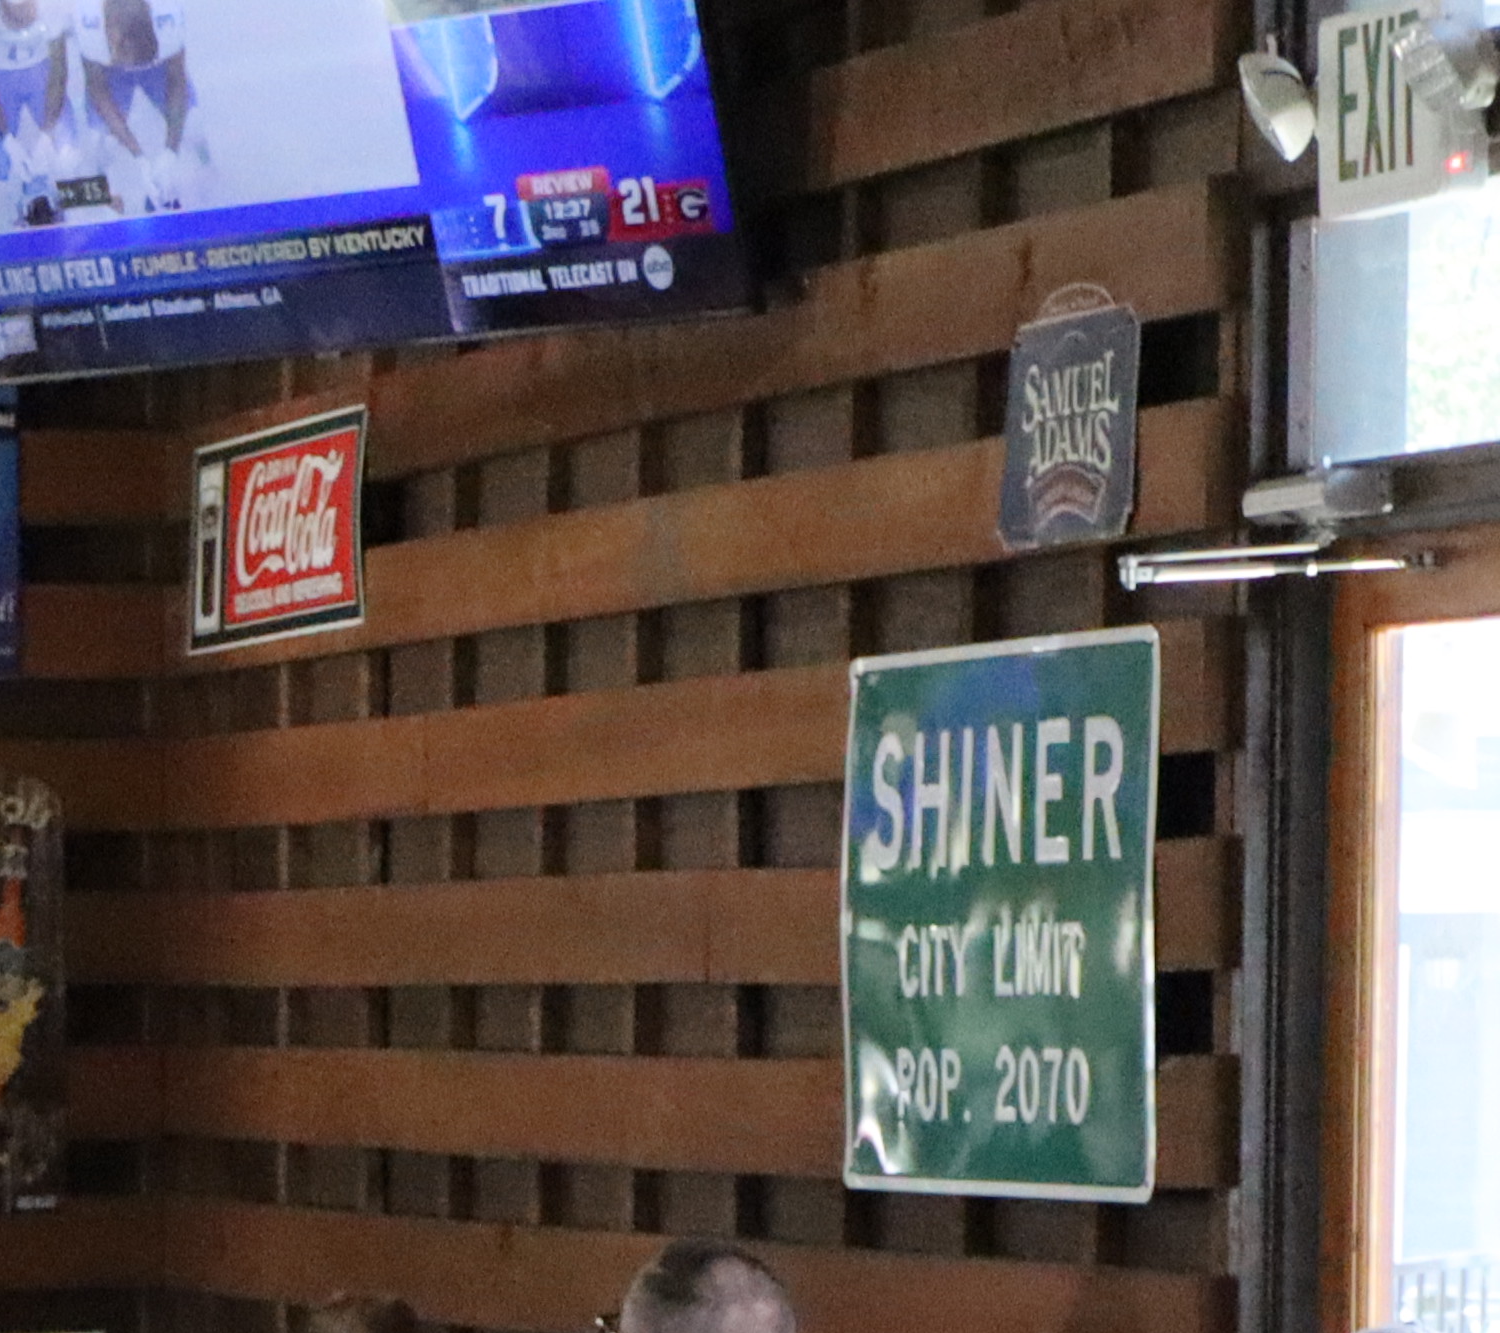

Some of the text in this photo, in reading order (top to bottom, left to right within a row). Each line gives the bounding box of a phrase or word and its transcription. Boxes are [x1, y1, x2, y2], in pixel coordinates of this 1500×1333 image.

[483, 193, 507, 239] 7
[530, 172, 594, 195] REVIEW
[618, 176, 660, 225] 21
[65, 257, 116, 290] FIELD
[131, 252, 198, 279] FUMBLE
[335, 225, 427, 256] KENTUCKY
[1022, 351, 1120, 433] SAMUEL
[1026, 411, 1112, 477] ADAMS
[866, 715, 1125, 874] SHINER
[899, 920, 1086, 1000] CITY LIMIT
[896, 1044, 1091, 1127] POP. 2070
